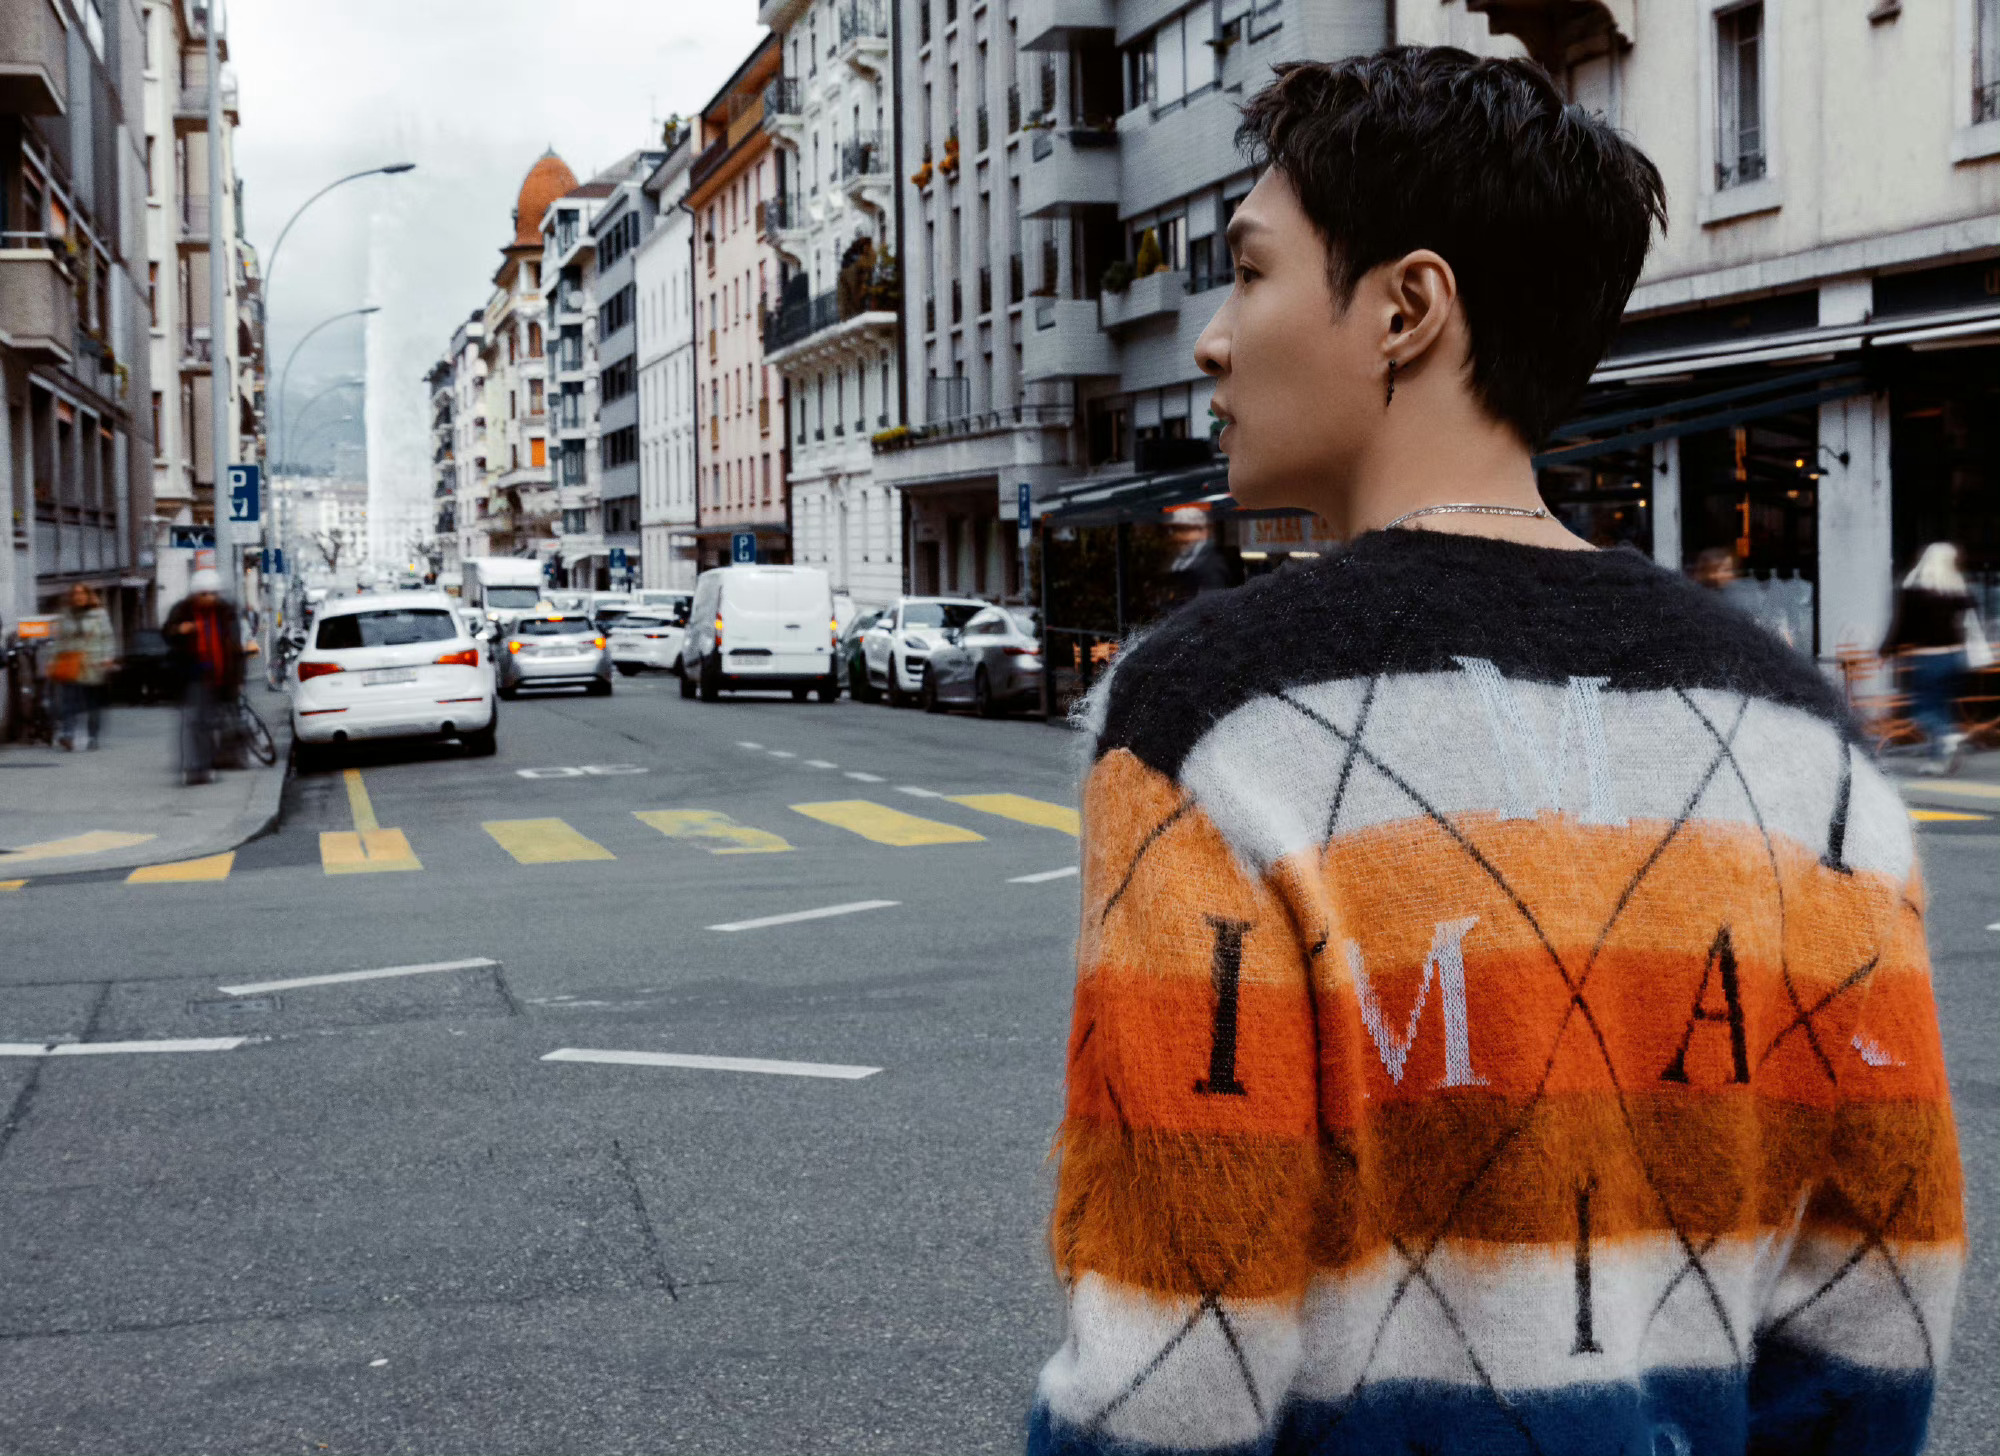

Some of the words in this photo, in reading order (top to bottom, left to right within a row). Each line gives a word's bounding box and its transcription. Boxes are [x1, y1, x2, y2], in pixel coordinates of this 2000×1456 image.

[227, 470, 248, 496] P
[738, 536, 749, 549] P
[1659, 922, 1750, 1084] A
